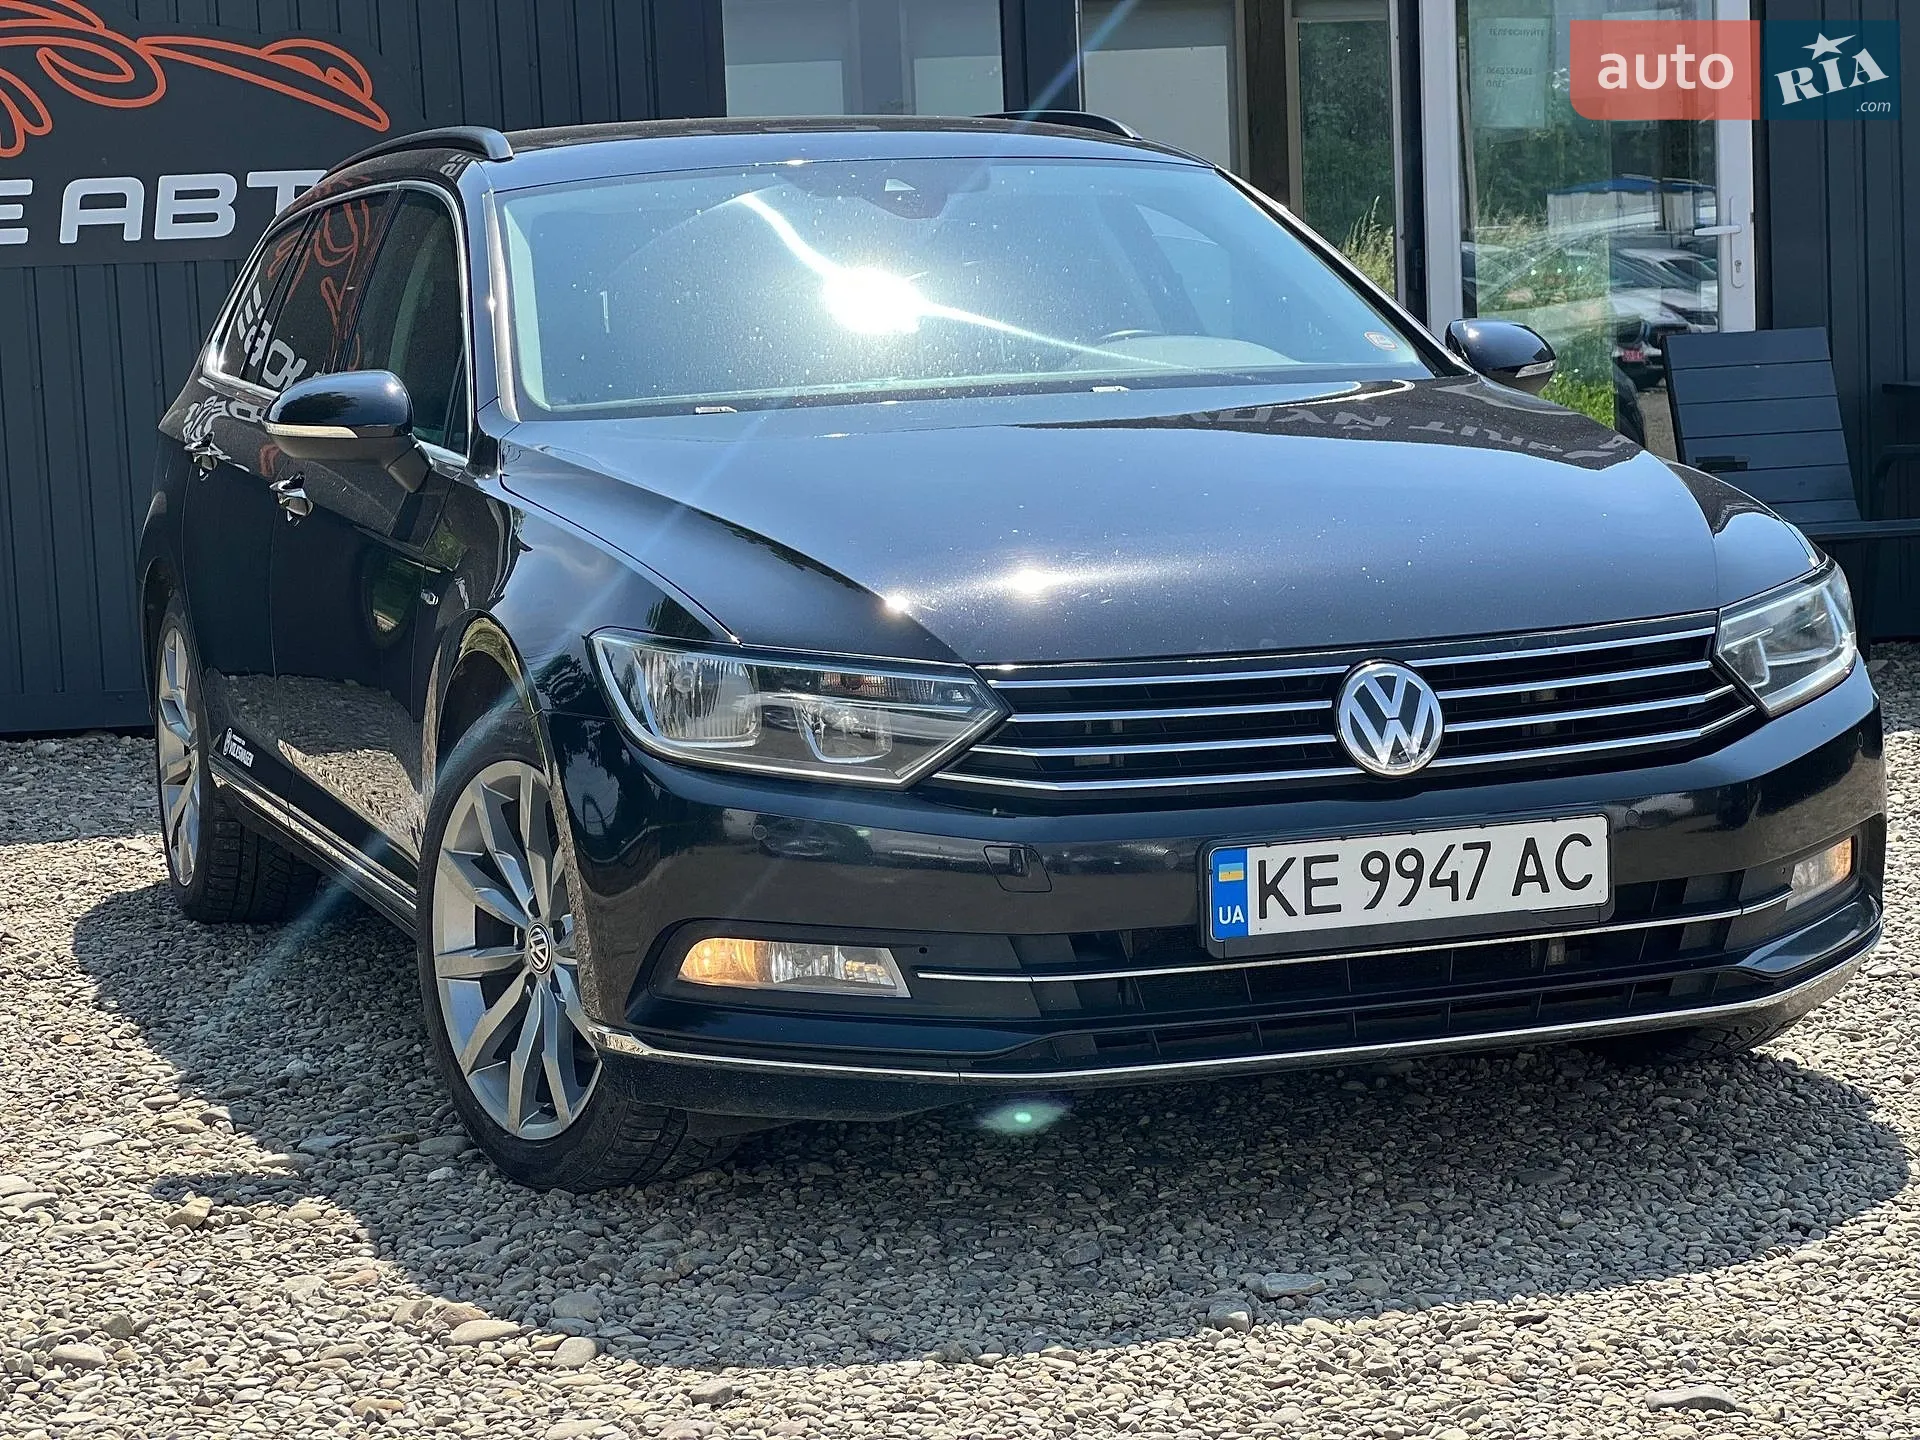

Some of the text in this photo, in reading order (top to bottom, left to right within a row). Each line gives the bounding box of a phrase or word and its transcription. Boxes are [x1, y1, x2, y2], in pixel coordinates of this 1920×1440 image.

[1257, 833, 1593, 920] KE 9947 AC
[1218, 906, 1245, 925] UA
